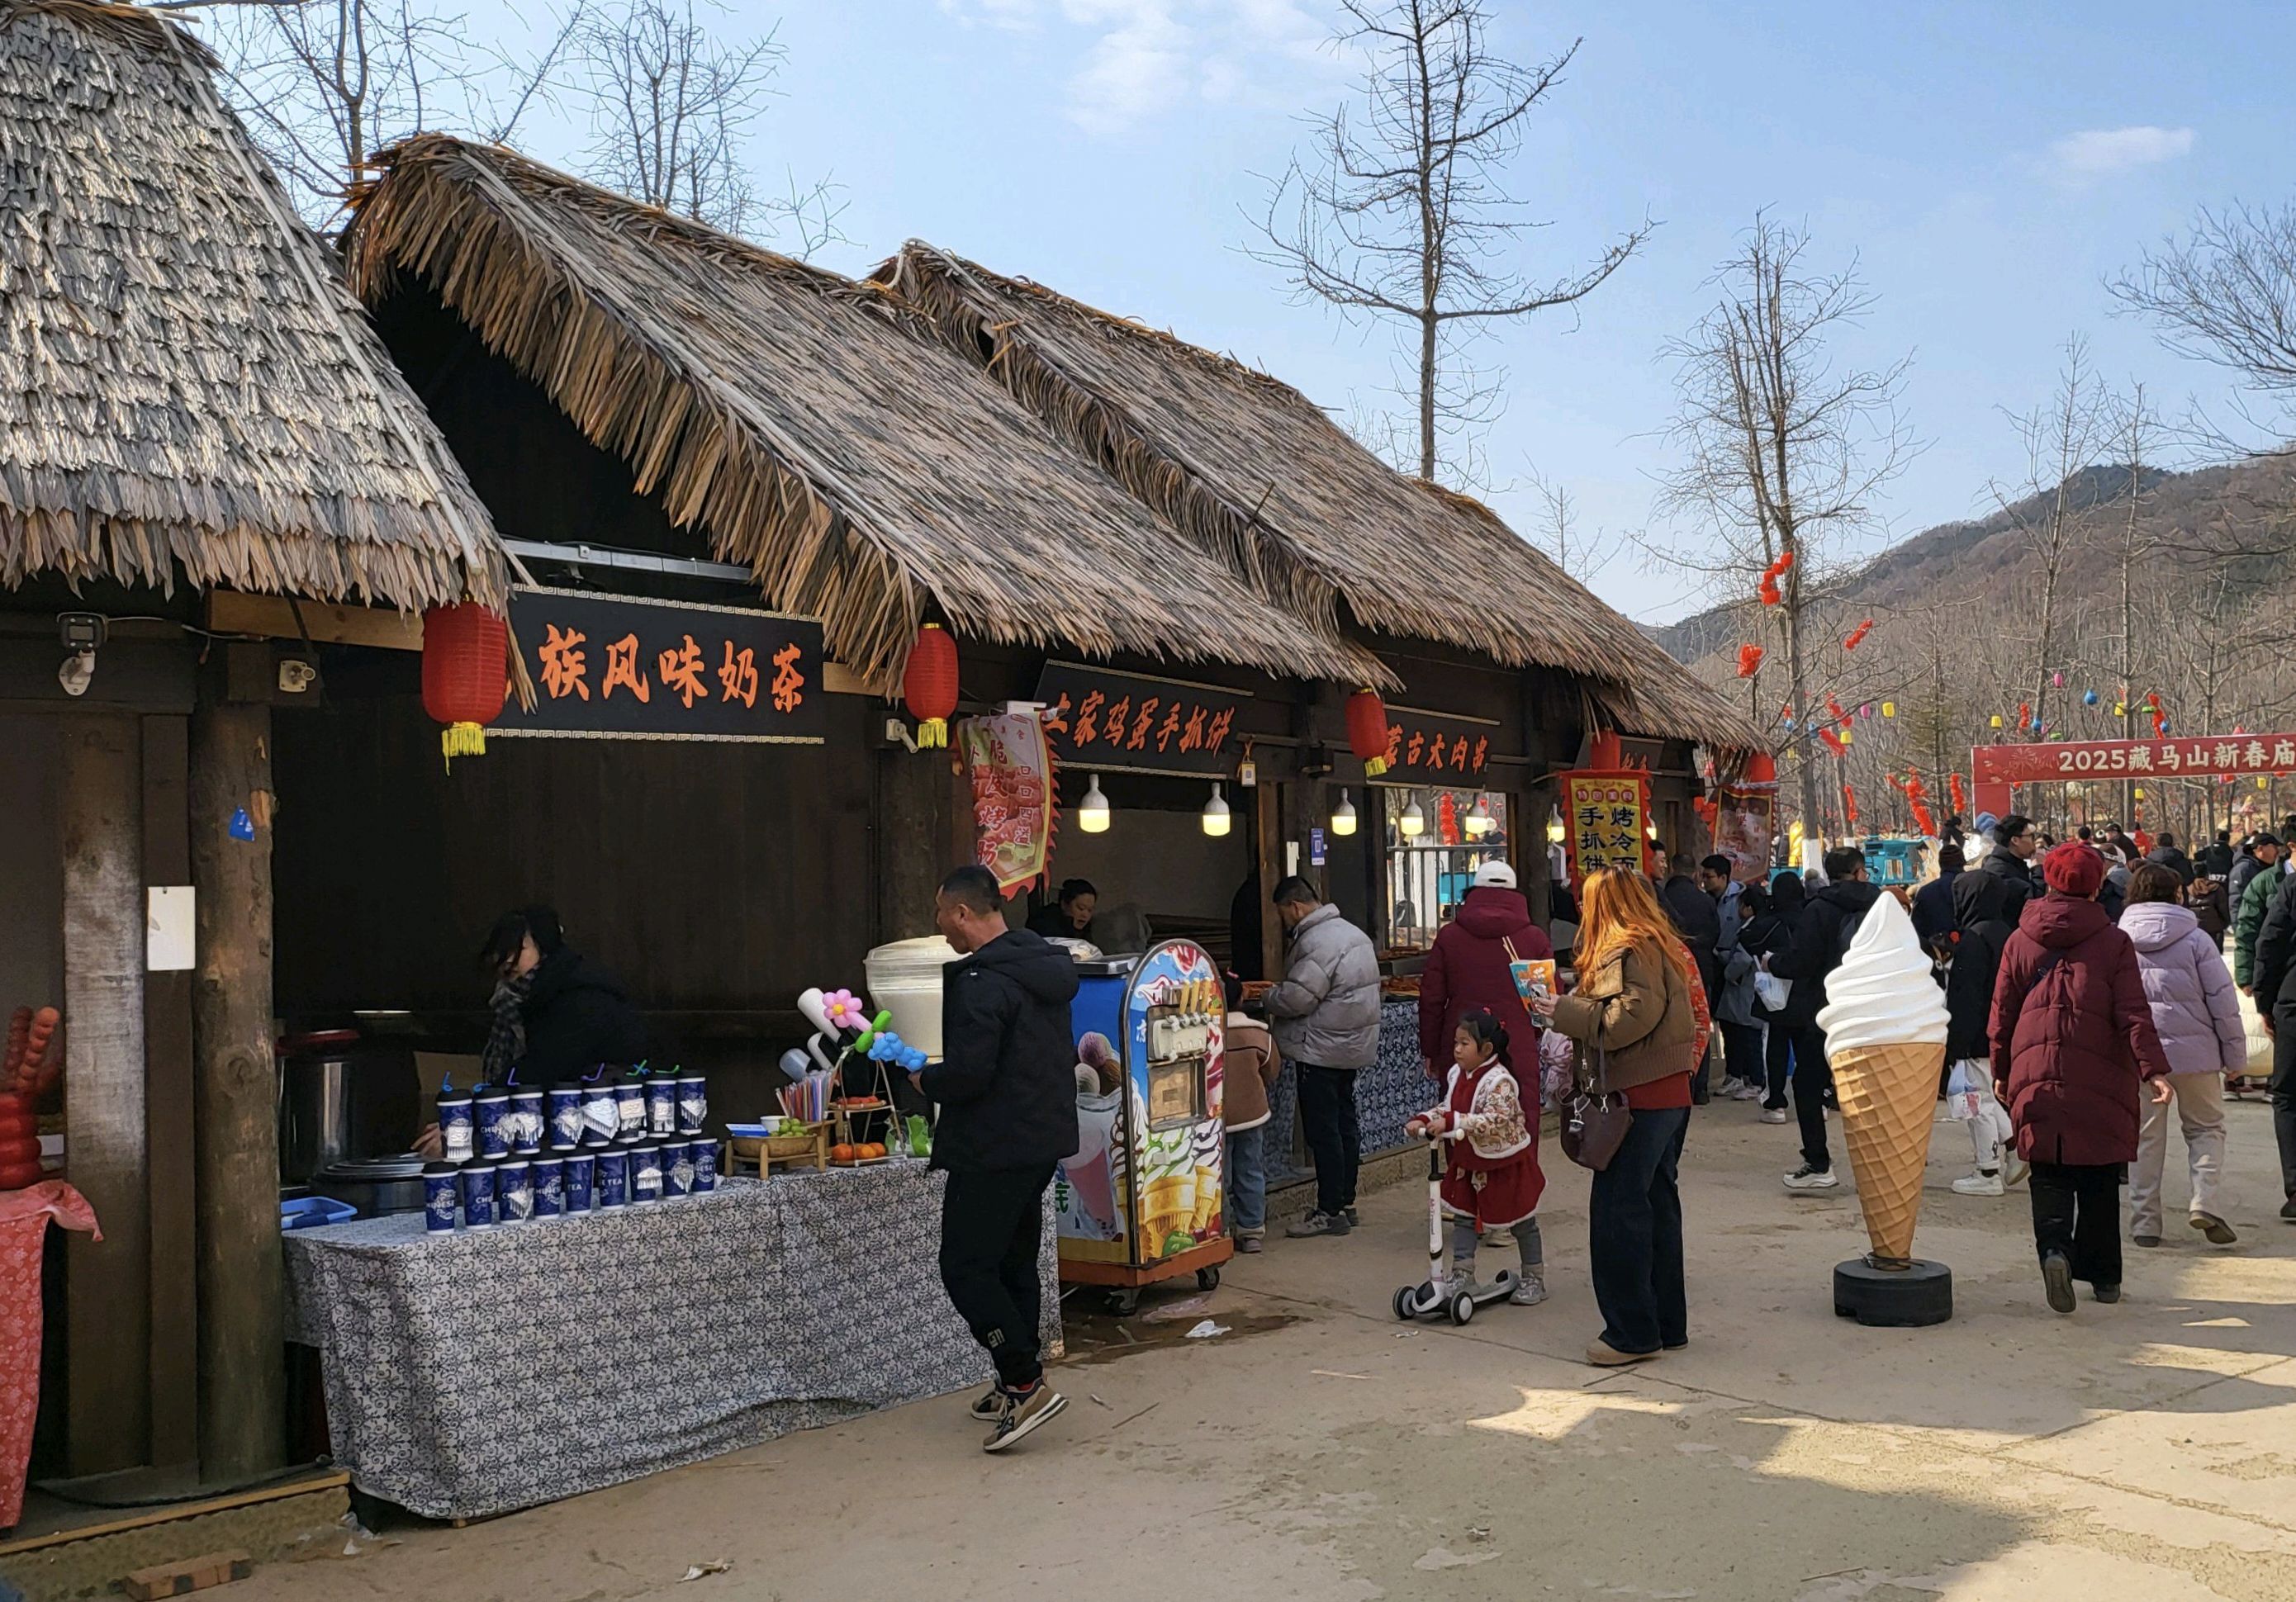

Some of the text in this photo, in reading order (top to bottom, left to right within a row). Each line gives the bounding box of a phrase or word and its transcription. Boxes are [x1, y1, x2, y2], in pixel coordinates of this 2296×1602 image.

[505, 623, 805, 713] 族风味奶茶
[2059, 739, 2295, 773] 2025藏马山新春庙
[1578, 807, 1607, 874] 手抓饼
